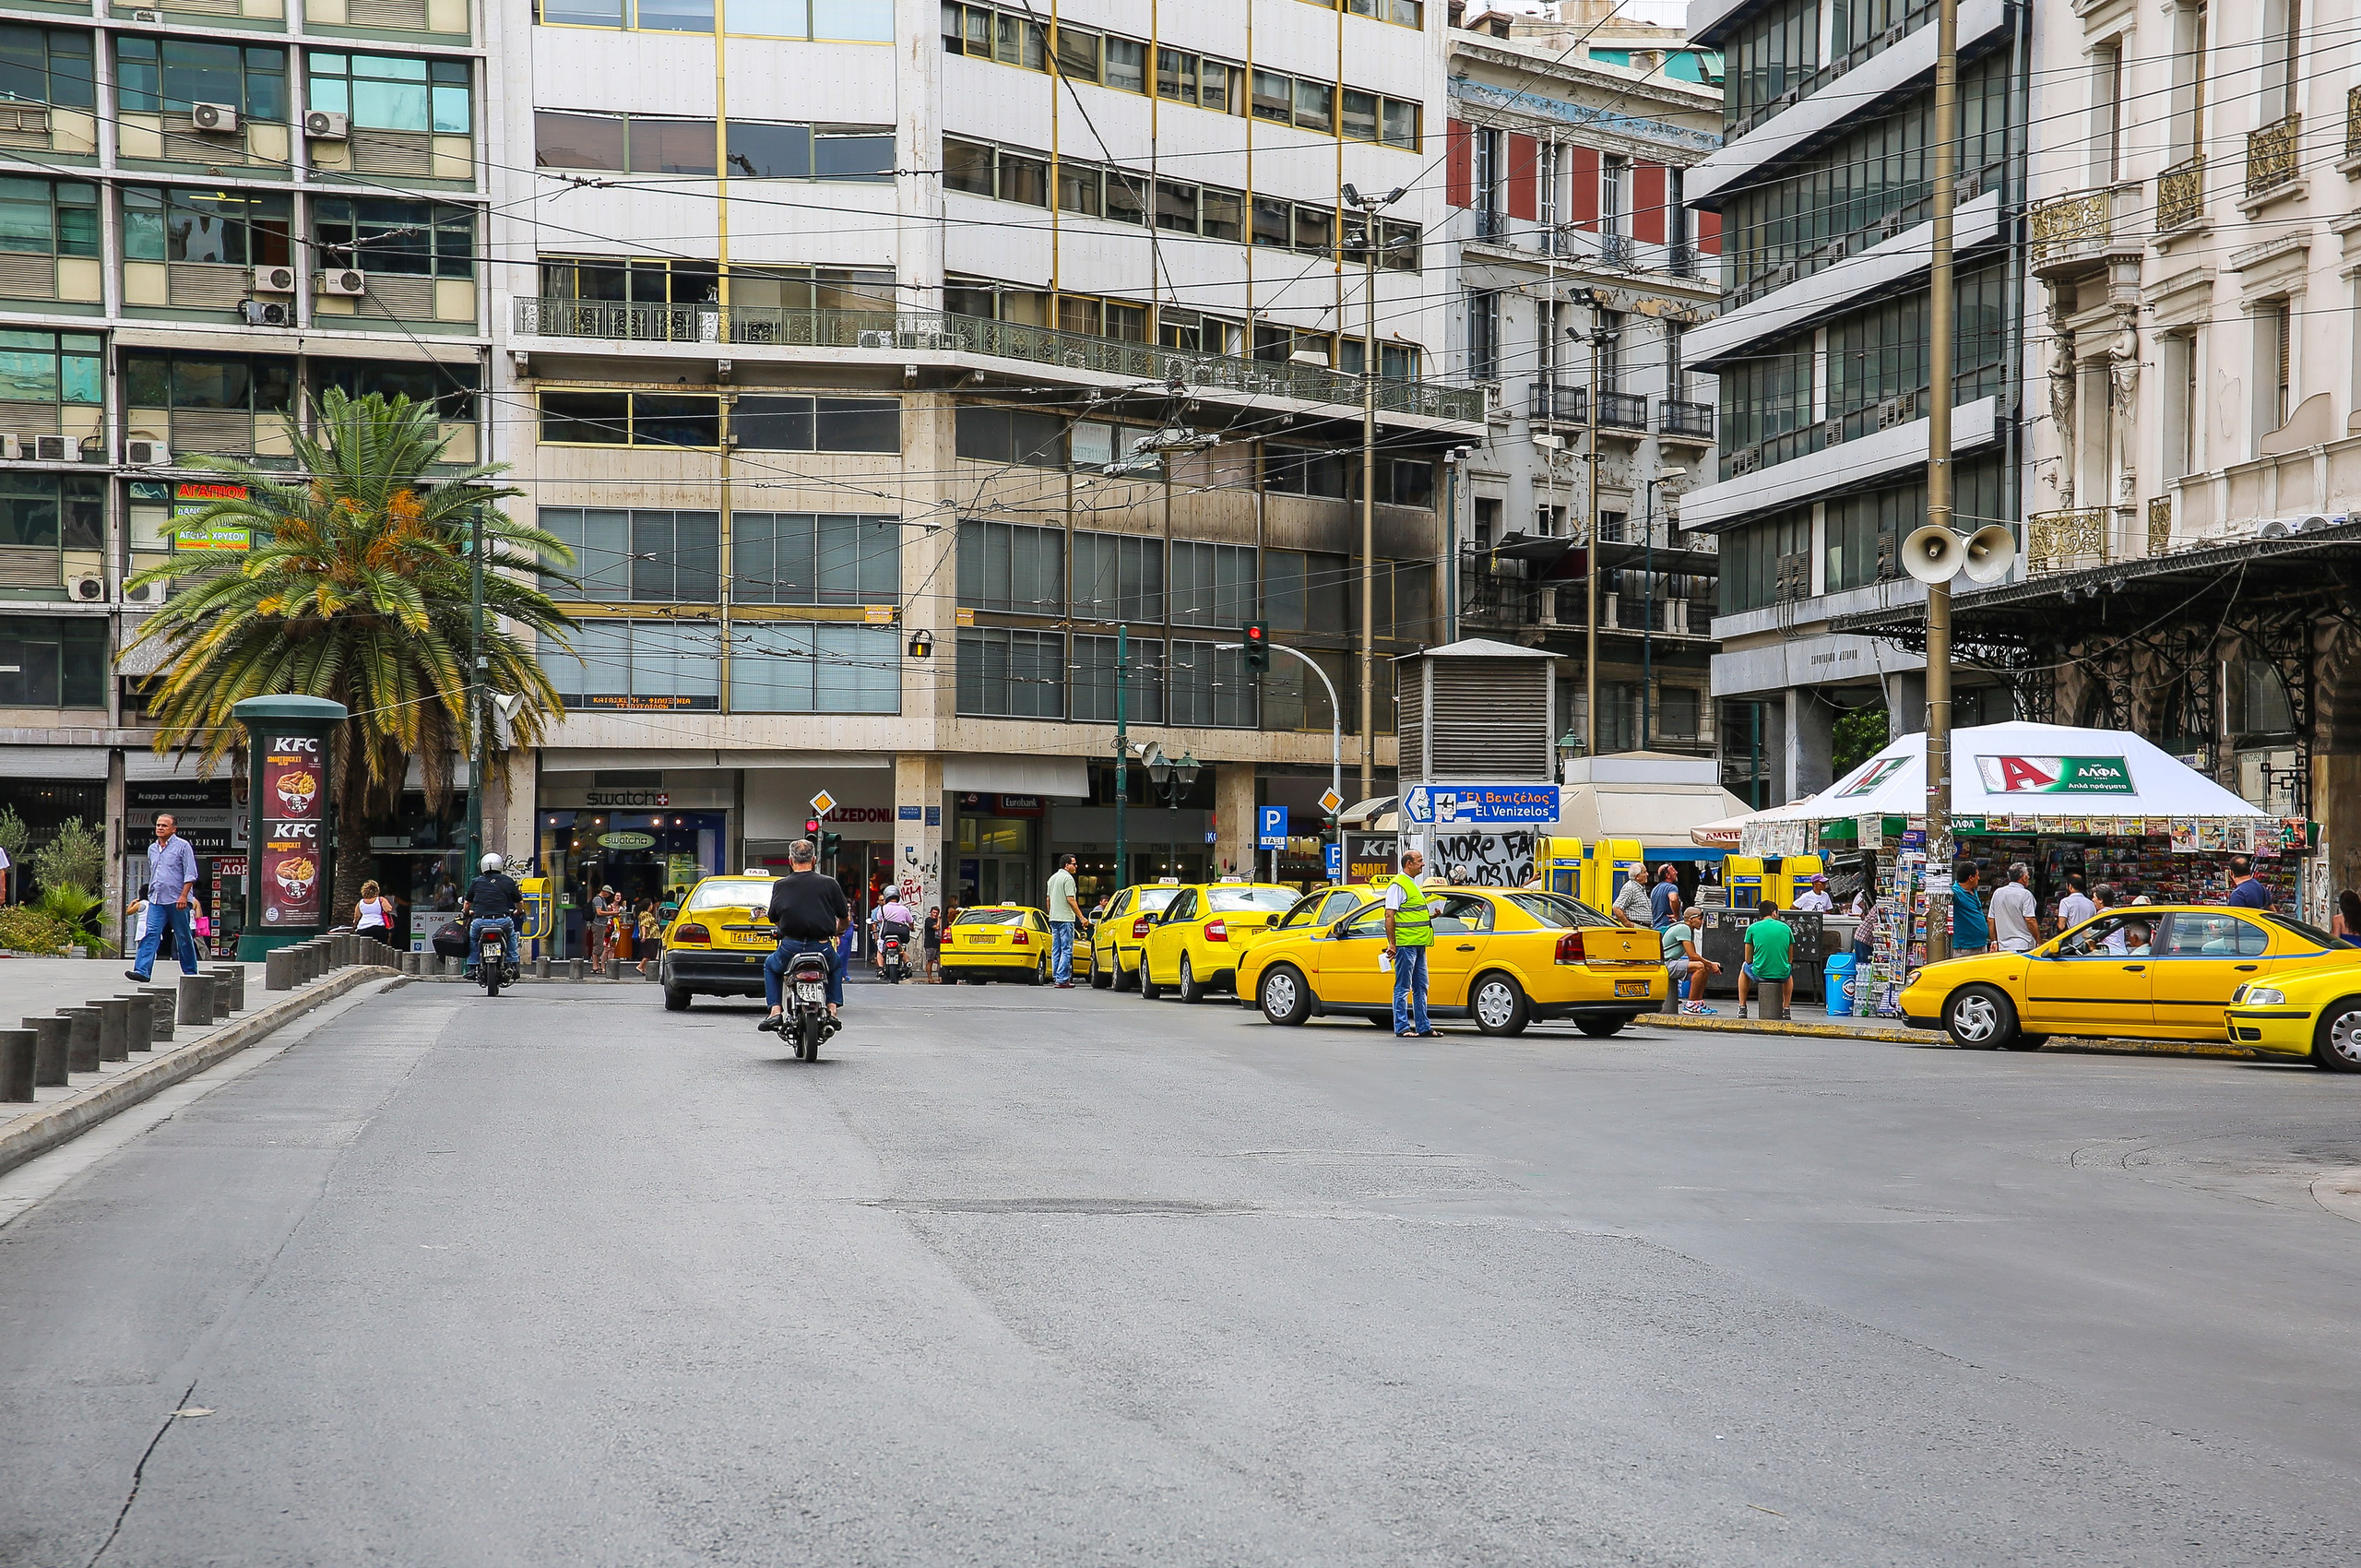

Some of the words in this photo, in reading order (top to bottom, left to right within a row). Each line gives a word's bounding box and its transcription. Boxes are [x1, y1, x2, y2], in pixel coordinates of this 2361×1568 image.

[178, 484, 247, 499] ΑΓΑΠΙΟΣ
[211, 531, 245, 540] ΧΡΥΣΟΥ
[273, 737, 319, 753] KFC
[2077, 767, 2121, 778] ΑΛΦΑ
[137, 792, 166, 801] kapa
[168, 792, 209, 801] change
[587, 790, 657, 806] swatch
[1005, 797, 1038, 808] Eurobank
[812, 807, 895, 823] ALZEDONI
[1476, 805, 1490, 816] El.
[198, 814, 227, 823] transfer
[1266, 810, 1281, 831] P
[273, 823, 317, 838] KFC
[1705, 831, 1742, 841] AMSTE
[604, 836, 641, 844] swatch
[1150, 843, 1179, 852] ΣΤΑΔΙΥ
[1359, 839, 1398, 857] KF
[1351, 862, 1388, 875] SMART
